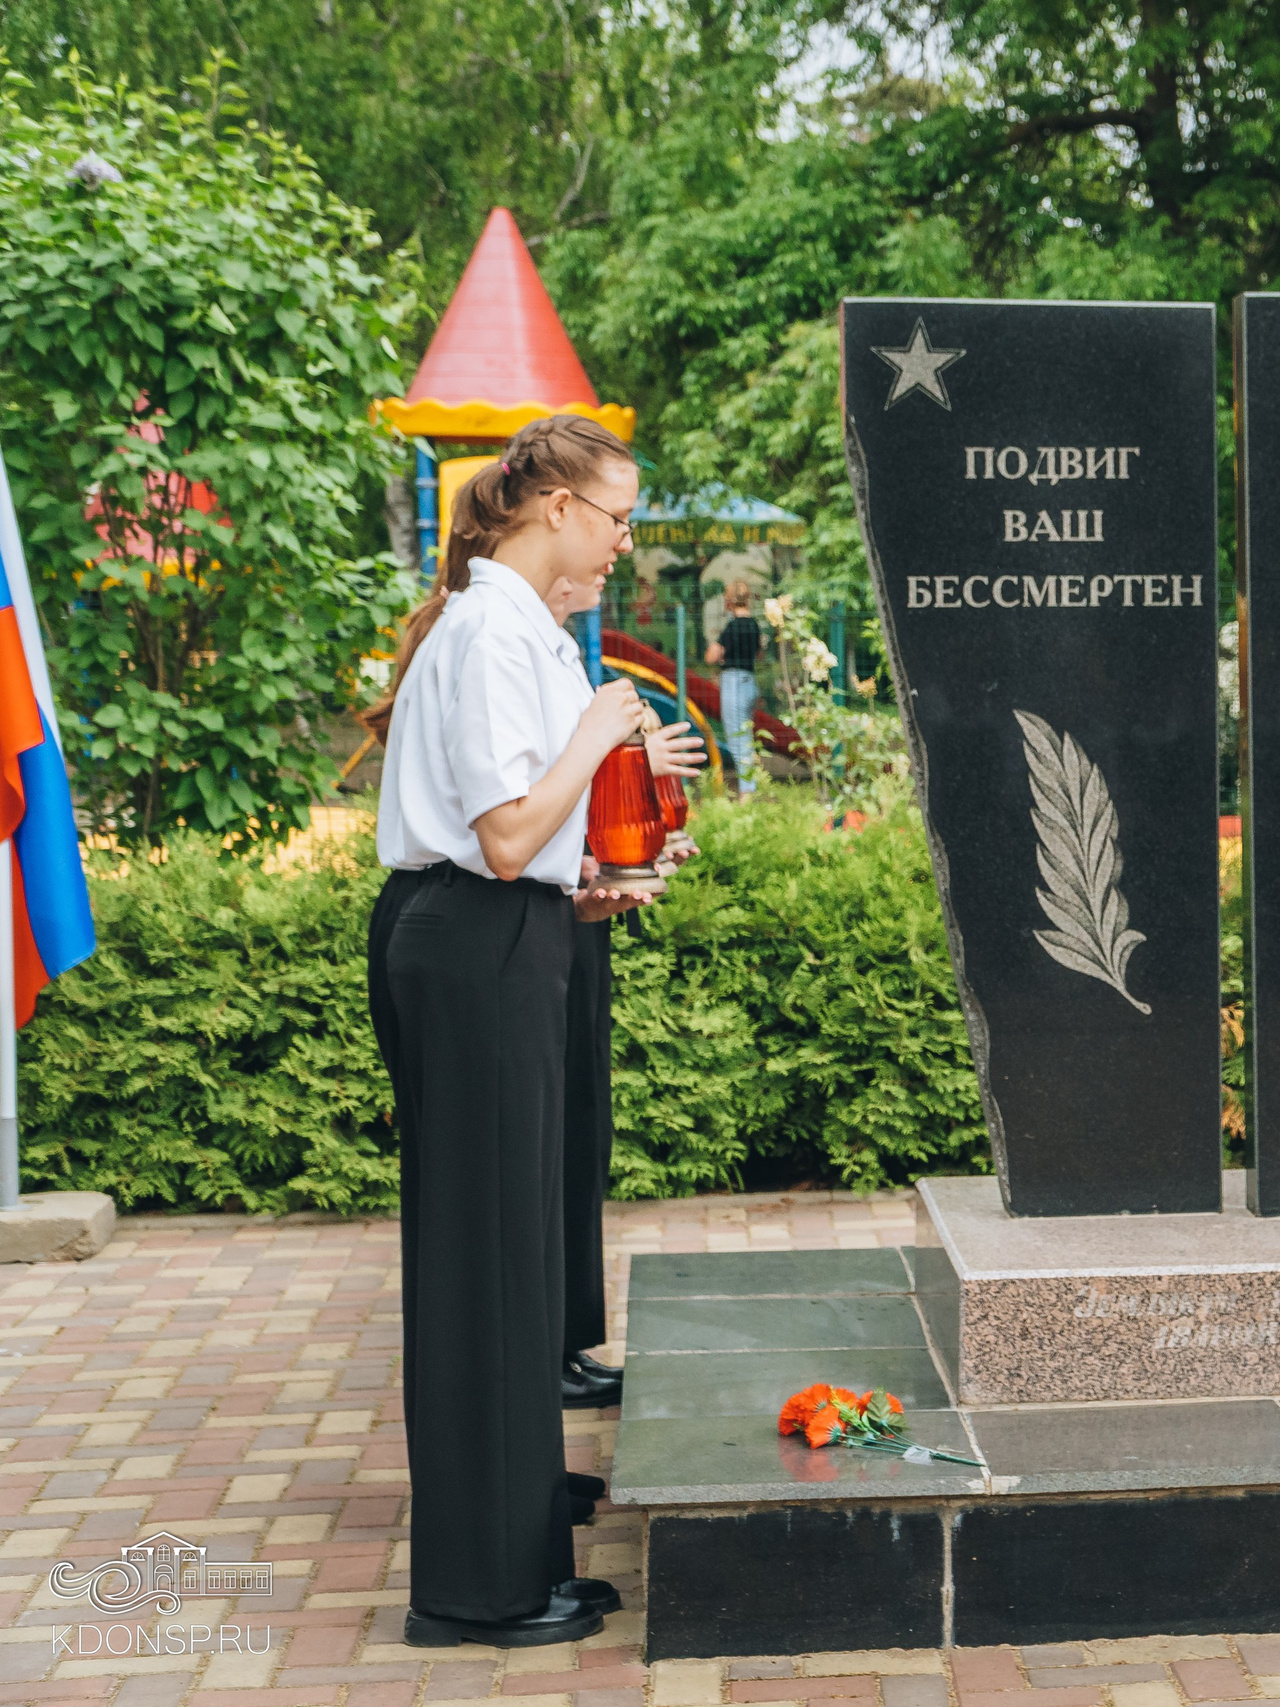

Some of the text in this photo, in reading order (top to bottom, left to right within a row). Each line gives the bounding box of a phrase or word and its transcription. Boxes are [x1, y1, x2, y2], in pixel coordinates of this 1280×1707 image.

[965, 446, 1141, 486] ПОДВИГ
[1002, 509, 1105, 542] ВАШ
[906, 573, 1203, 609] БЕССМЕРТЕН
